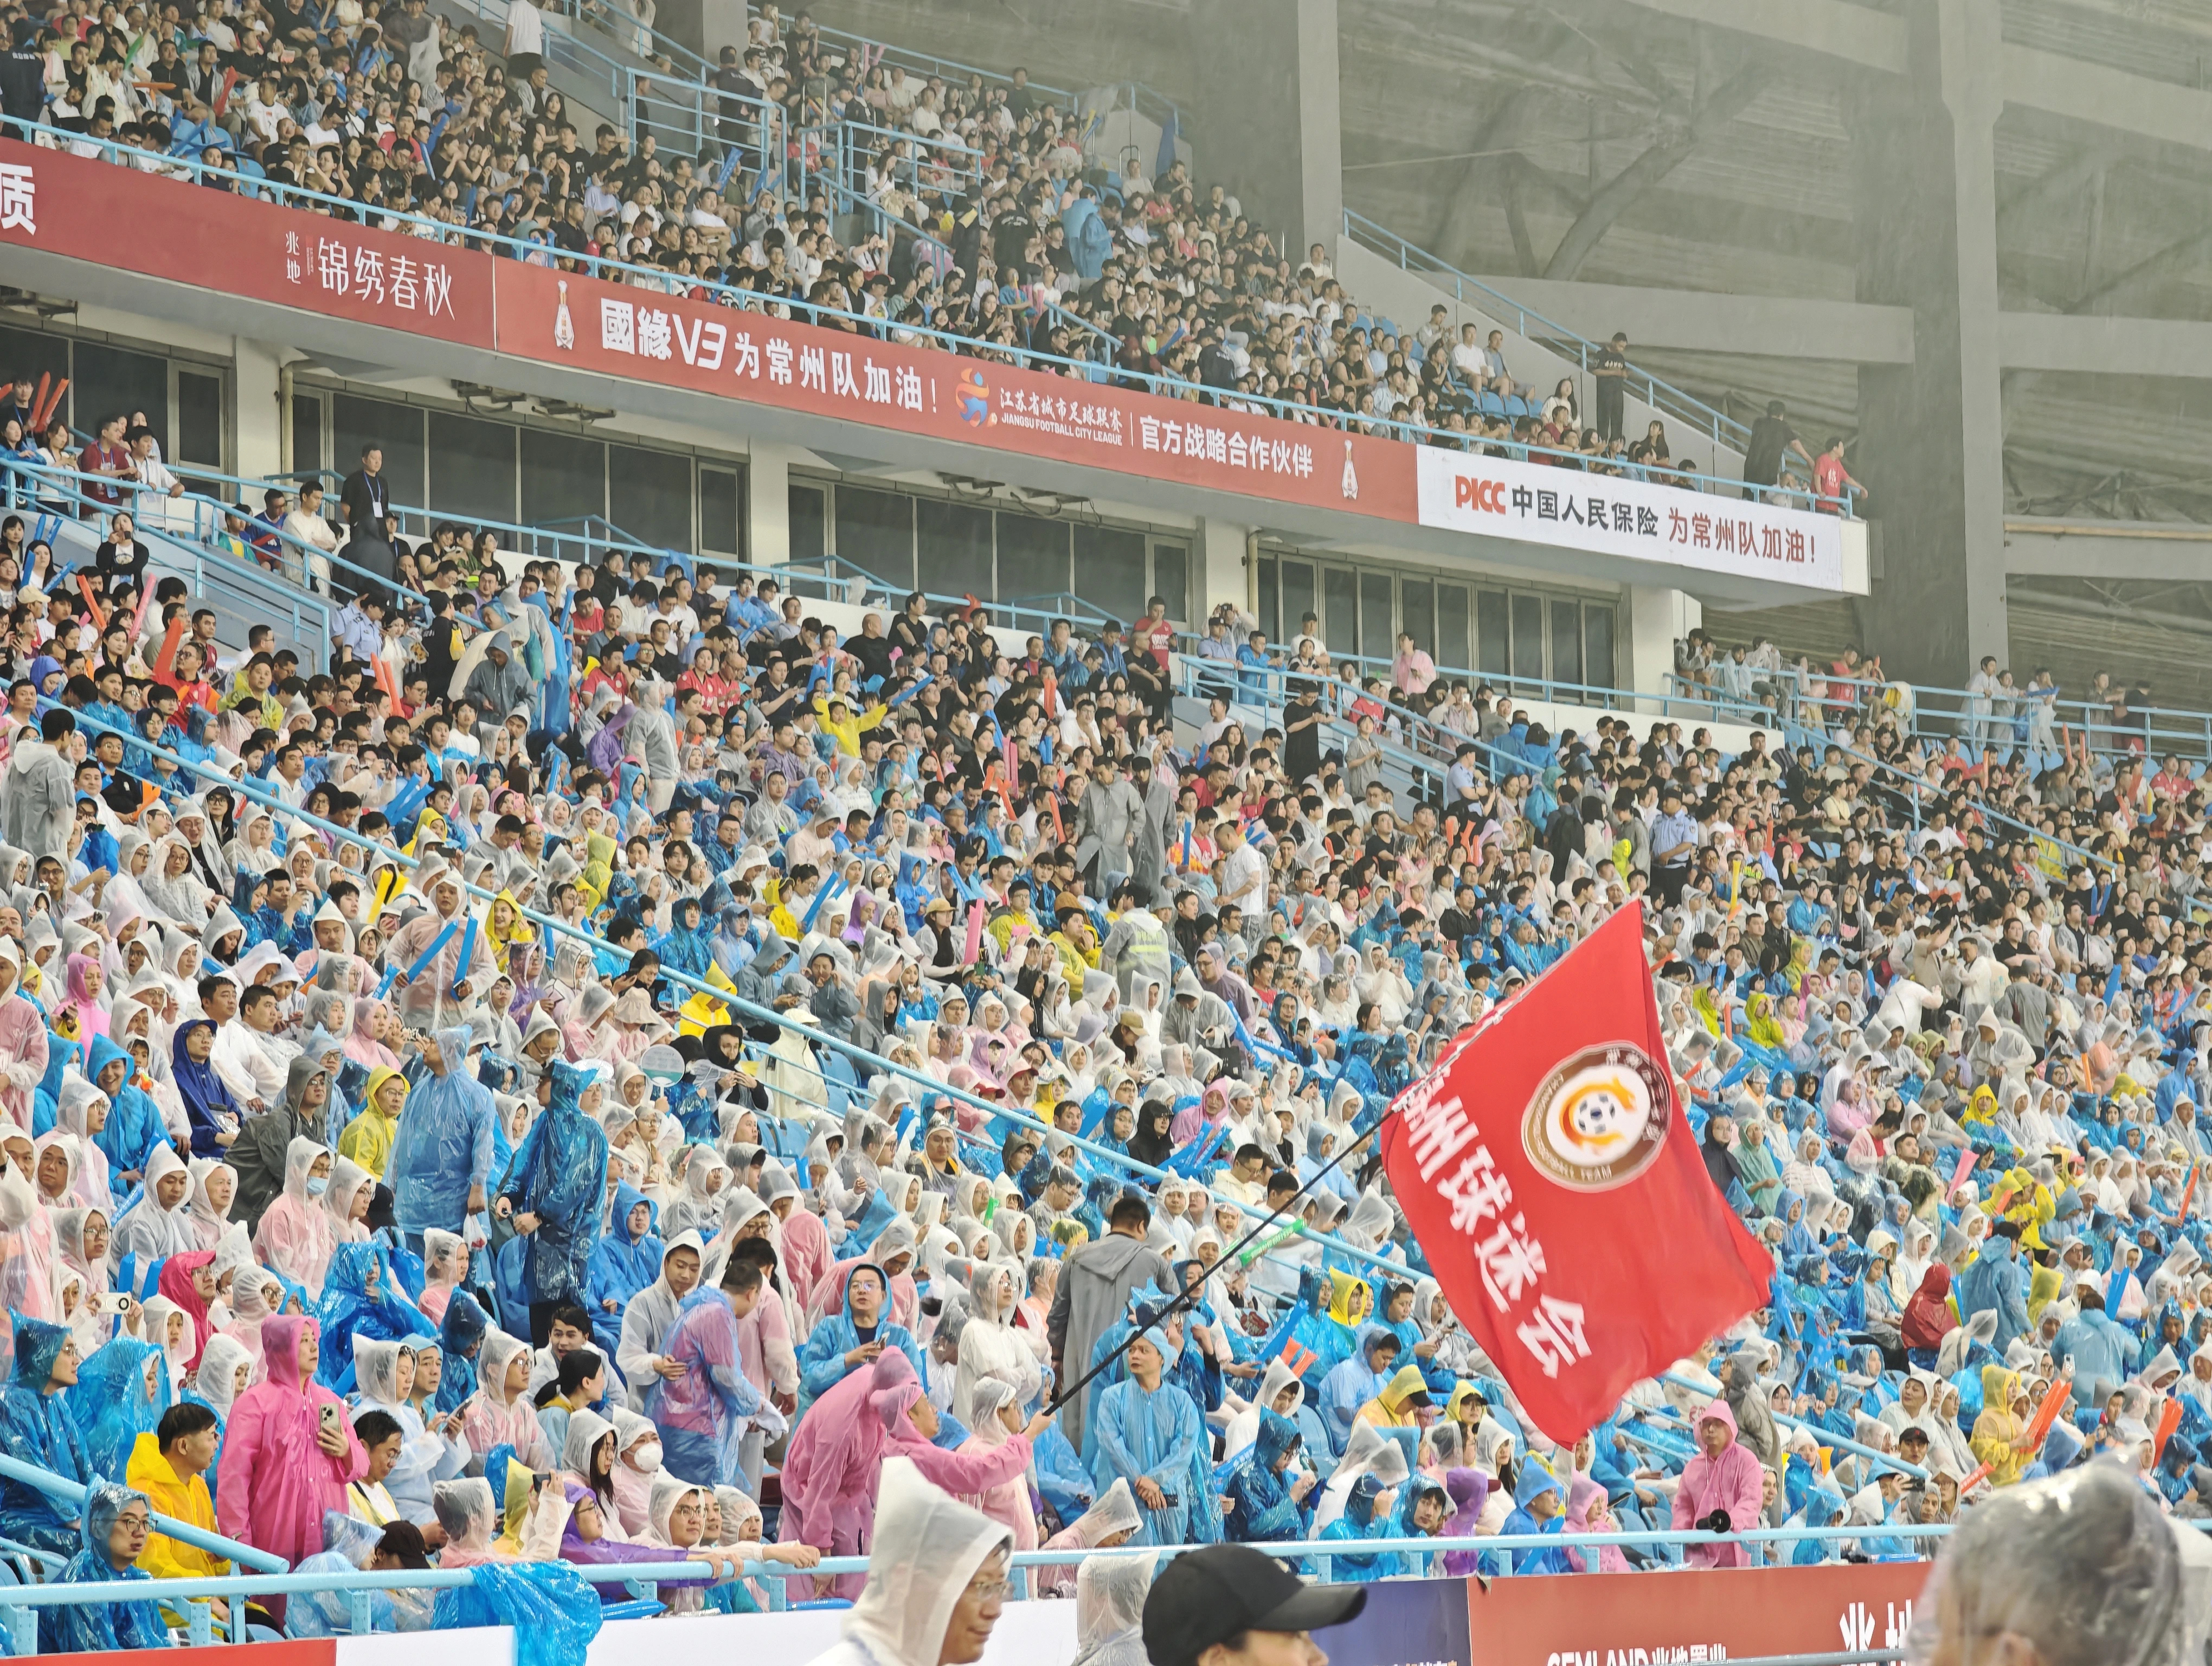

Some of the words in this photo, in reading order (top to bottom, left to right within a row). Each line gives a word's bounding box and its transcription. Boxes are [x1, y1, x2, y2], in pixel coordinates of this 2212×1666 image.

[0, 163, 36, 235] 质
[285, 230, 301, 284] 兆地
[318, 238, 456, 320] 锦绣春秋
[735, 332, 937, 413] 为常州队加油！
[1000, 387, 1123, 433] 江苏省城市足球联赛
[1001, 413, 1035, 429] JIANGSU
[1036, 419, 1075, 437] FOOTBALL
[1075, 426, 1092, 440] CITY
[1093, 429, 1123, 446] LEAGUE
[1140, 416, 1313, 478] 官方战略合作伙伴
[1456, 475, 1506, 514] PICC
[1513, 484, 1658, 537] 中国人民保险
[1669, 507, 1815, 564] 为常州队加油！
